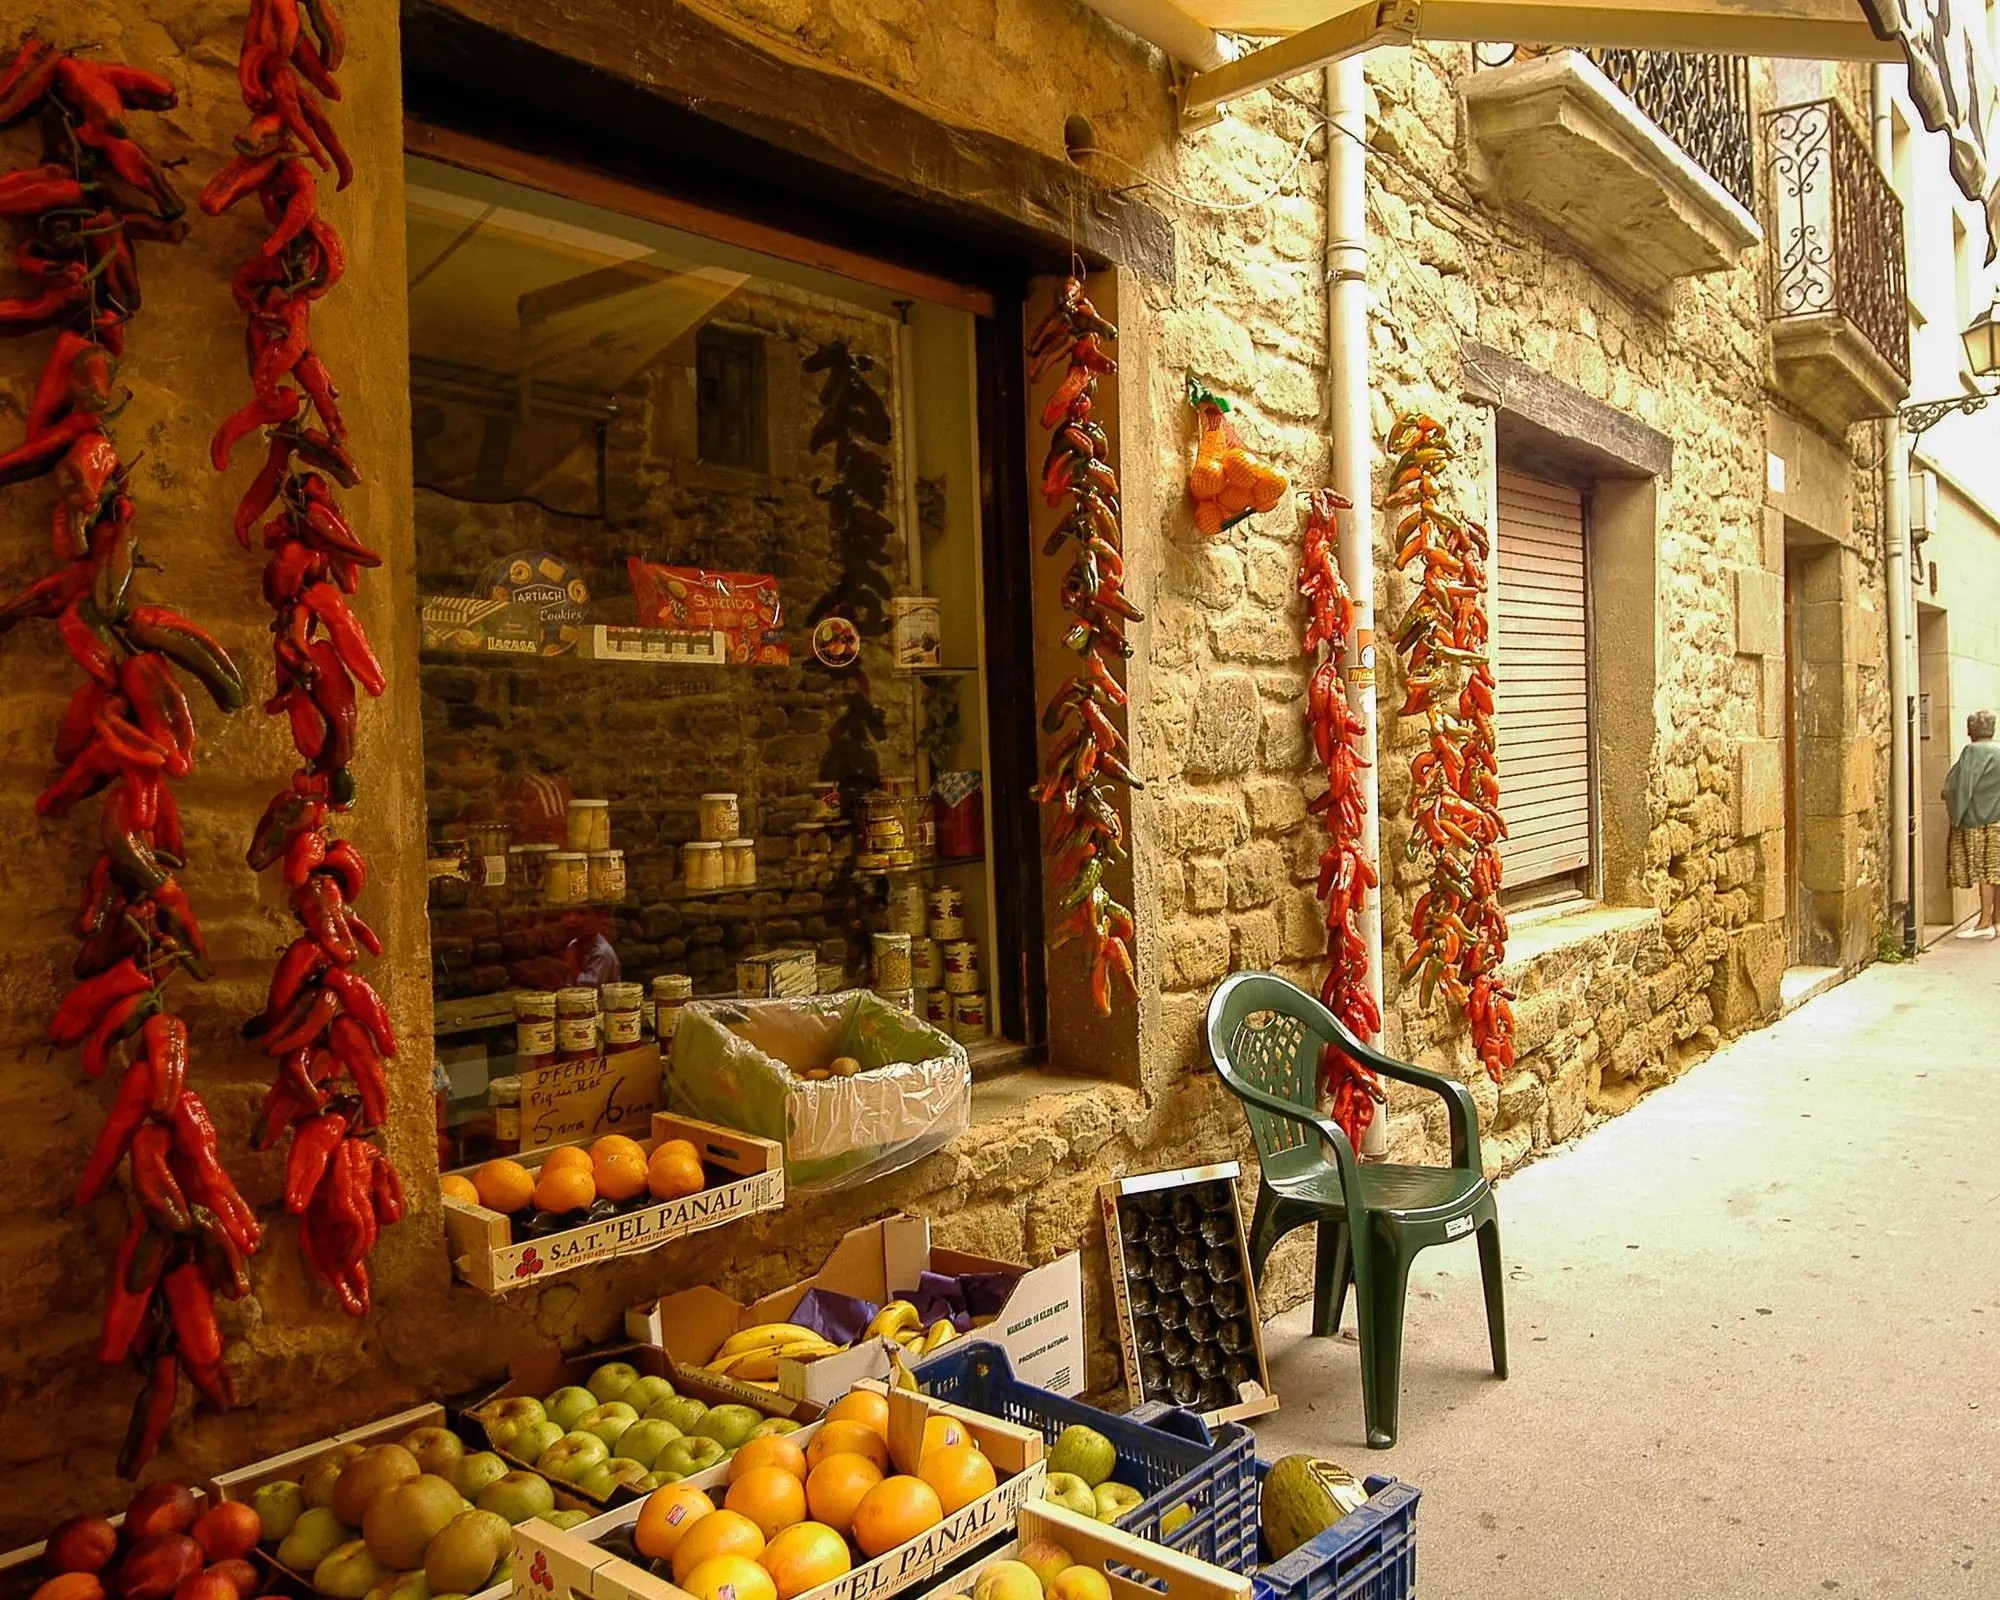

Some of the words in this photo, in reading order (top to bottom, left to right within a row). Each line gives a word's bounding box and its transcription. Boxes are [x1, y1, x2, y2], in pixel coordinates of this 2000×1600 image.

[517, 590, 563, 604] ARTIACH
[693, 593, 755, 610] SURTIDO
[540, 609, 582, 621] Cookies
[538, 1056, 608, 1086] OFERTA
[532, 1108, 559, 1145] 5
[550, 1234, 603, 1261] S.A.T.
[605, 1215, 651, 1243] "EL
[657, 1182, 751, 1230] PANAL"
[1018, 1346, 1047, 1365] PRODUCTO
[1046, 1334, 1069, 1351] NATURAL
[897, 1489, 1008, 1577] PANAL"
